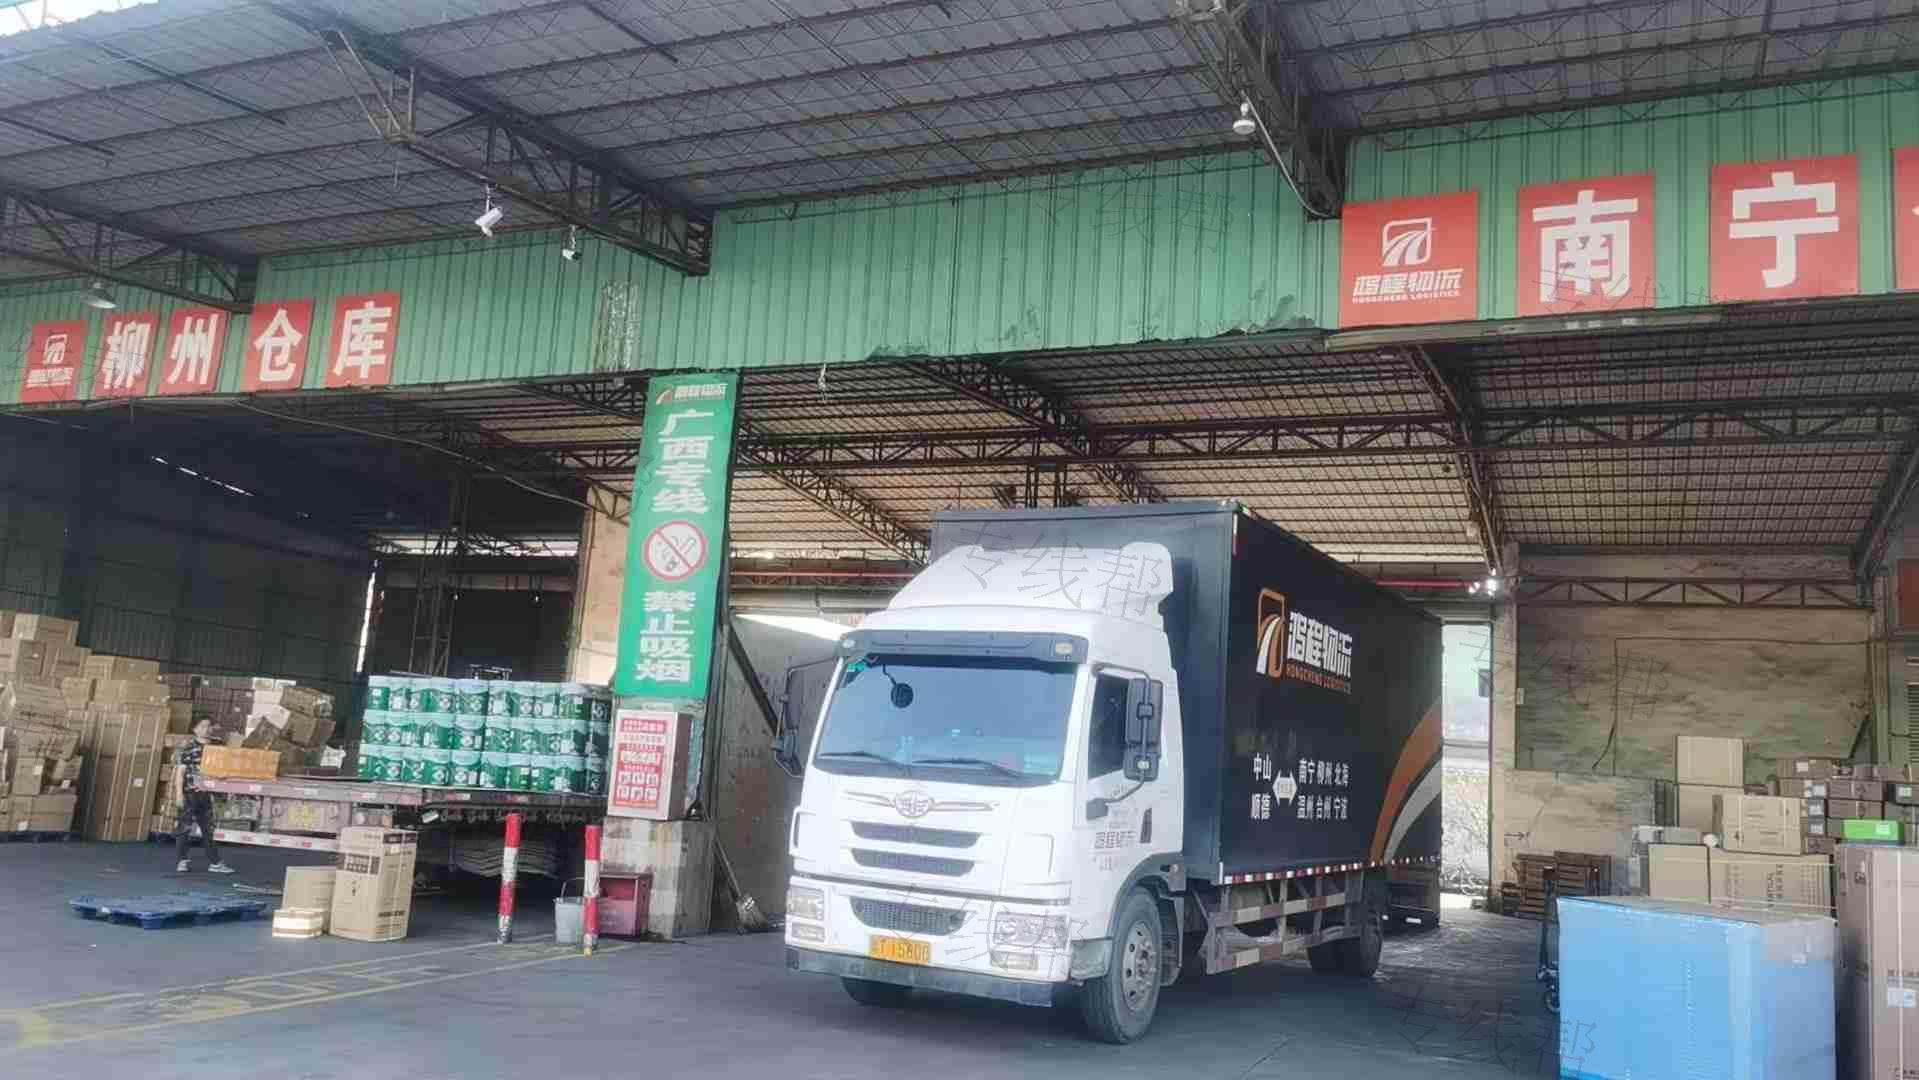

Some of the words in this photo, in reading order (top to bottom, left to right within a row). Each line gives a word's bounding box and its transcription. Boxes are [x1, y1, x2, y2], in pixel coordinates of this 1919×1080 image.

[1532, 171, 1919, 303] 南宁
[102, 300, 393, 389] 柳州仓库
[651, 409, 715, 514] 广西专线
[635, 591, 696, 683] 禁止吸烟
[1253, 752, 1272, 781] 中山
[1299, 758, 1315, 784] 南宁
[1317, 760, 1332, 785] 柳州
